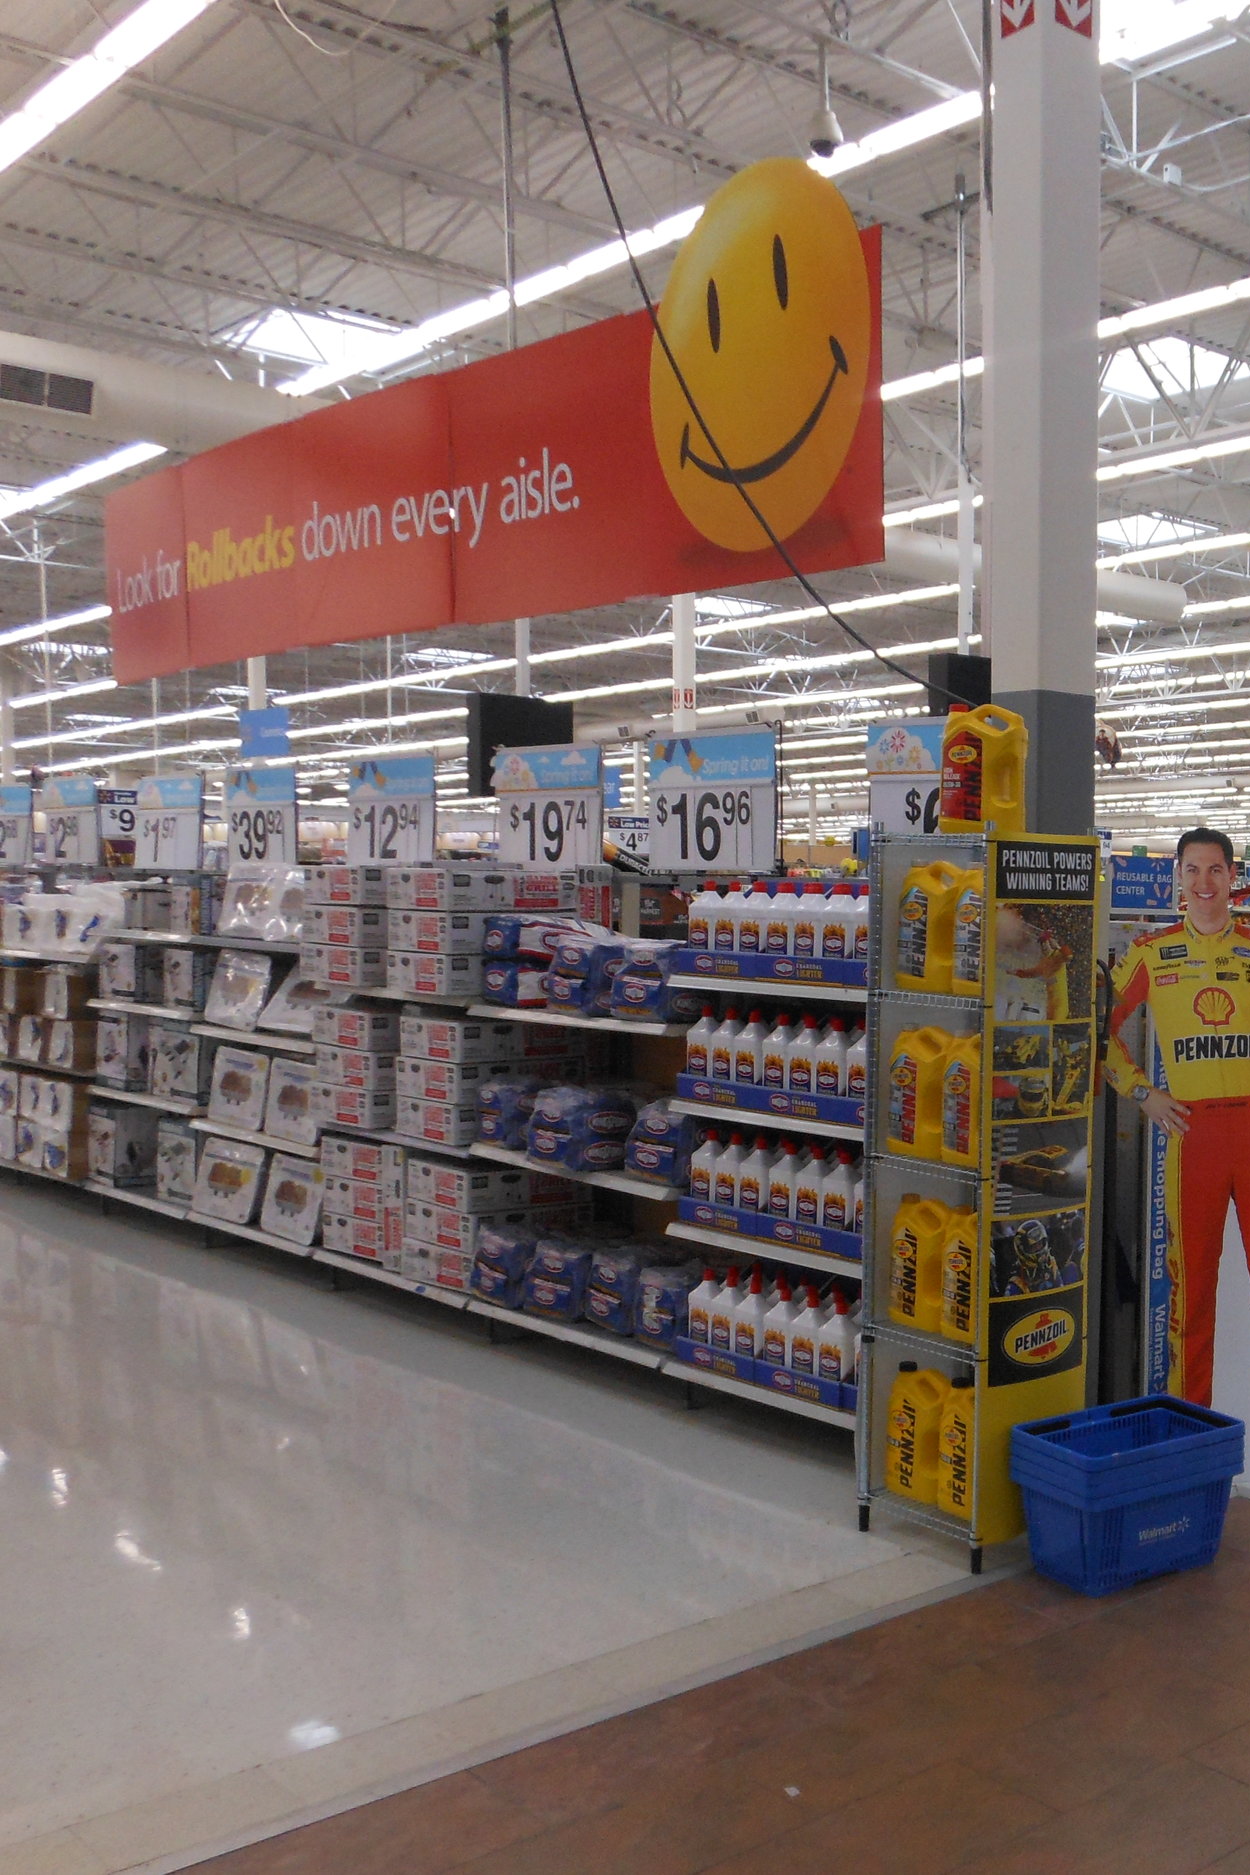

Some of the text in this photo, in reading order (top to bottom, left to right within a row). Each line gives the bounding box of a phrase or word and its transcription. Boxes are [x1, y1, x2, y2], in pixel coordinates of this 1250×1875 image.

[116, 447, 580, 613] Look for Rollbacks down every aisle.
[703, 758, 740, 775] Spring
[1002, 850, 1092, 870] PENNZOIL POWERS
[1006, 873, 1089, 892] WINNING TEAMS!
[1116, 871, 1172, 884] REUSABLE BAG
[1116, 886, 1145, 896] CENTER
[1152, 1244, 1166, 1280] bag
[1014, 1318, 1070, 1354] PENNZOIL
[1154, 1304, 1167, 1379] Walmart
[1139, 1522, 1177, 1541] Walmart
